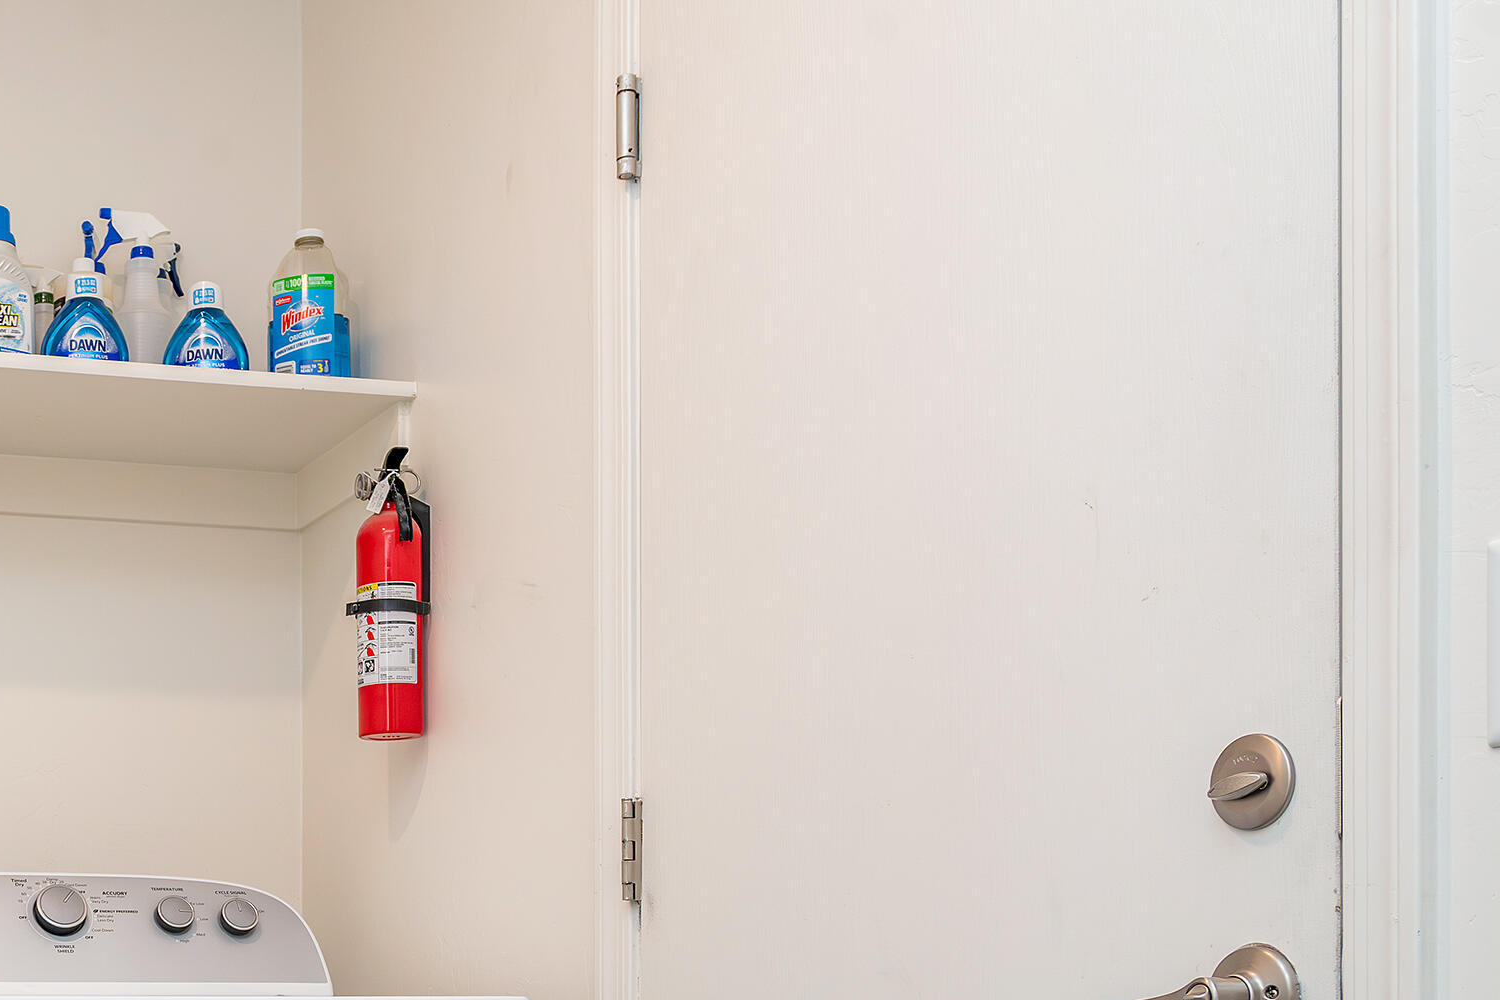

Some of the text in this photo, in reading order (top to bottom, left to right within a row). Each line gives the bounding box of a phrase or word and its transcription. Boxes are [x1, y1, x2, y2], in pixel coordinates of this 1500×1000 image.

[281, 305, 325, 336] Windex
[69, 339, 107, 352] DAWN
[186, 349, 224, 362] DAWN
[317, 363, 324, 373] 3
